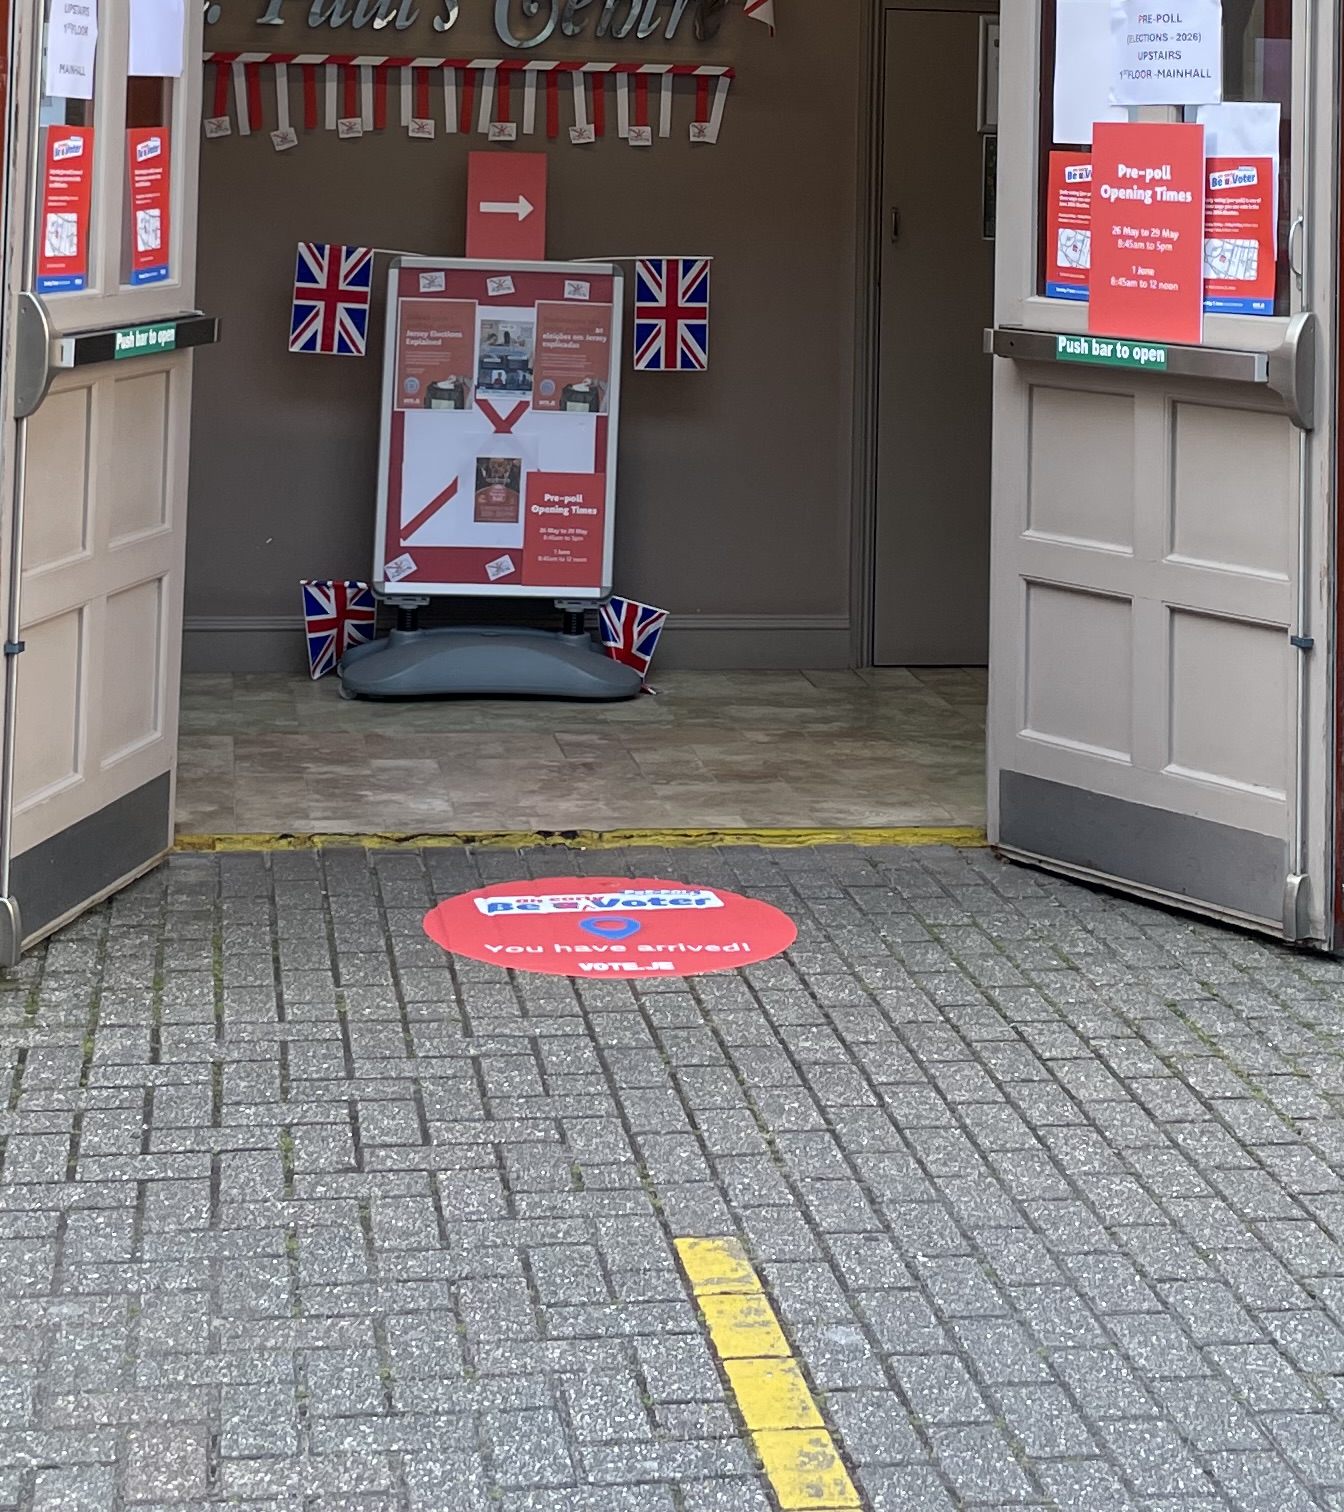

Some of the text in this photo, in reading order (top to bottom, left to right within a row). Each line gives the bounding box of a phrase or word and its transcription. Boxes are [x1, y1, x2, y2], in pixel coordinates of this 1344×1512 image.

[64, 3, 90, 17] UPSTAIRS
[1138, 13, 1183, 24] PRE-POLL
[1176, 32, 1202, 44] 2026)
[1137, 50, 1182, 61] UPSTAIRS
[1117, 164, 1172, 182] Pre-poll
[1211, 177, 1223, 188] Be
[1232, 173, 1256, 186] Voter
[1100, 185, 1192, 204] Opening Times
[1112, 226, 1180, 241] 26 May to 29 May
[1117, 239, 1173, 253] 8:45am to 5pm
[1138, 266, 1155, 276] June
[1140, 279, 1148, 288] to
[1150, 280, 1157, 289] 12
[1159, 281, 1178, 291] noon
[116, 328, 175, 350] Push bar to open
[1058, 336, 1165, 364] Push bar to open
[544, 494, 584, 505] Pre-poll
[531, 504, 598, 516] Opening Times
[487, 901, 541, 914] Be
[594, 894, 712, 911] Voter
[484, 941, 751, 954] You have arrived!
[578, 960, 676, 972] VOTE.JE
